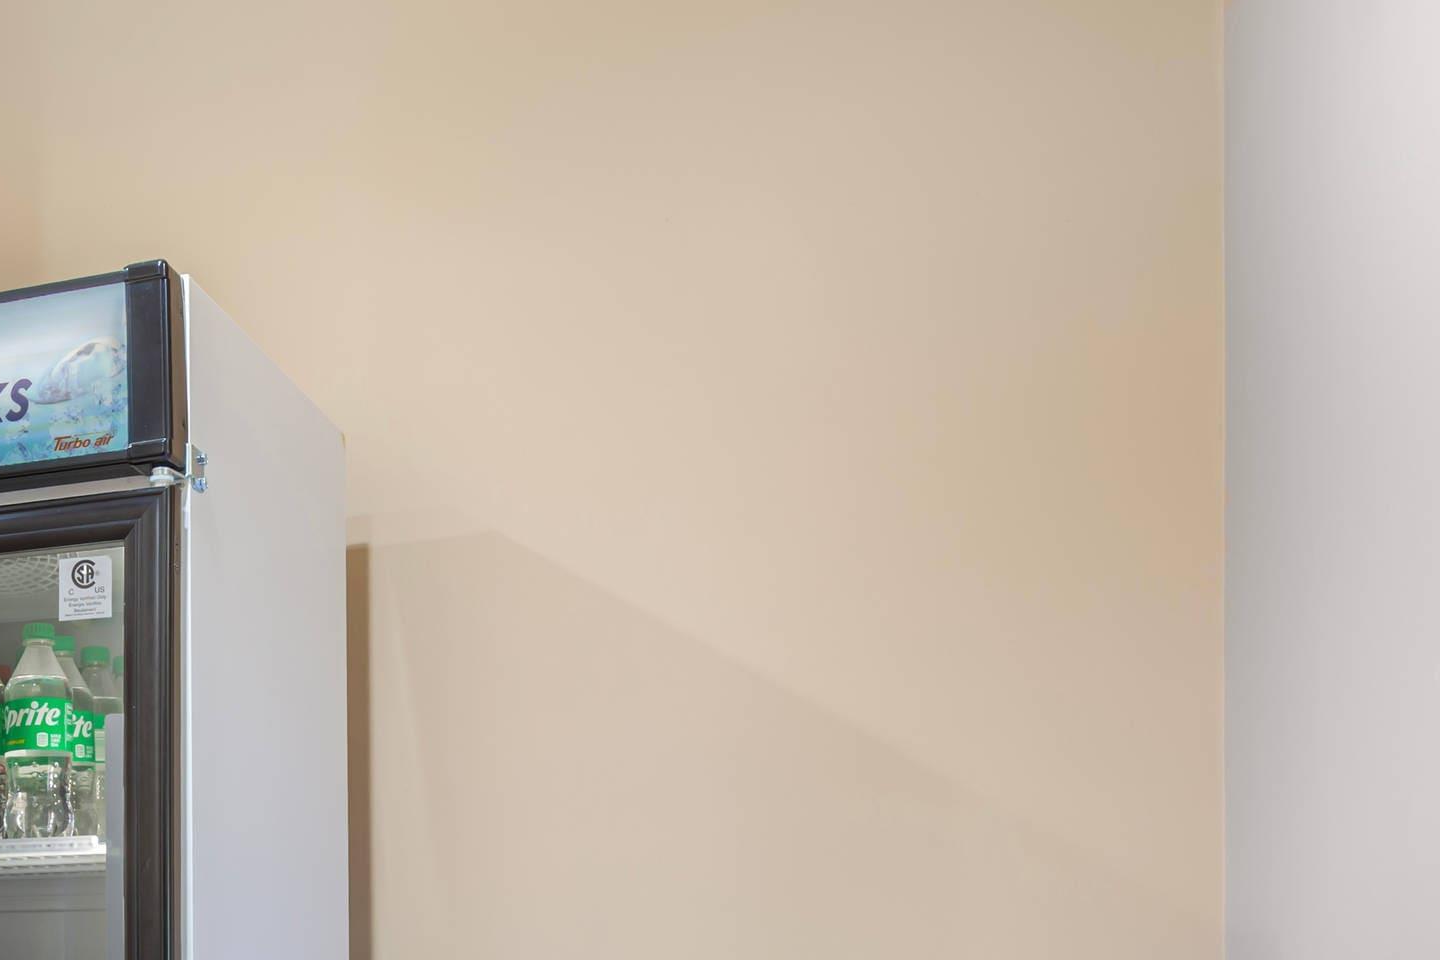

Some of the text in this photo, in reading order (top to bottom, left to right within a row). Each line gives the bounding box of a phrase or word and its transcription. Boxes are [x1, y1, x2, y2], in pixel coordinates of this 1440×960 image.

[54, 433, 114, 451] Turbo air
[5, 701, 60, 735] prite
